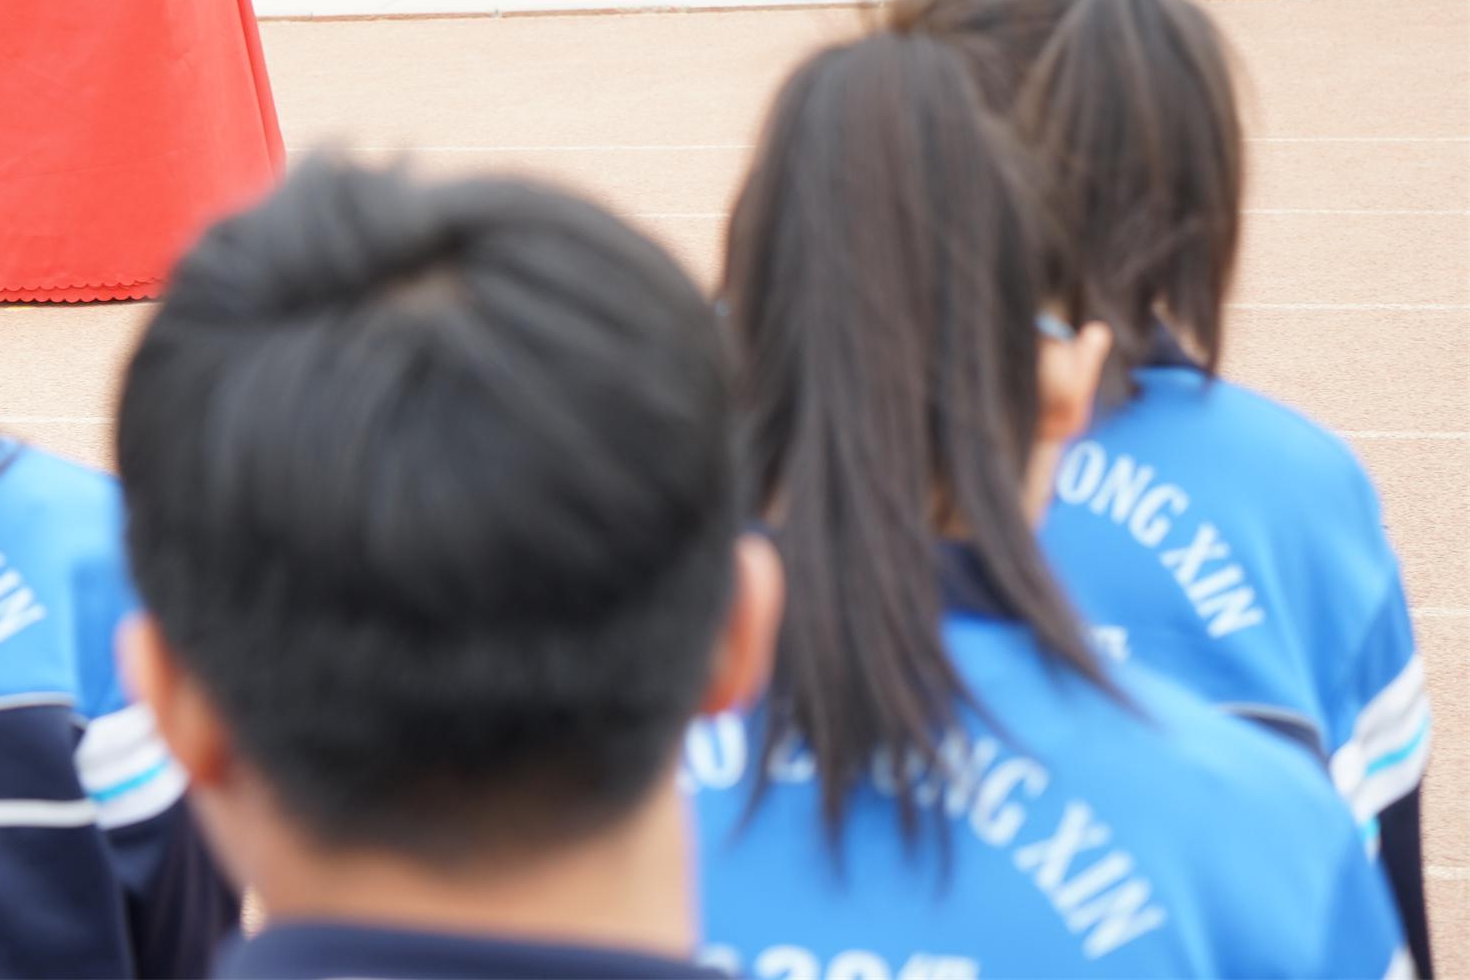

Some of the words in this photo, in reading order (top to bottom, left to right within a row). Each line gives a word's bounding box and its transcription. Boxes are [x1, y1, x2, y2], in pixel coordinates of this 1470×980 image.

[1057, 439, 1189, 548] ONG
[1159, 521, 1265, 639] XIN
[1012, 798, 1167, 959] XIN
